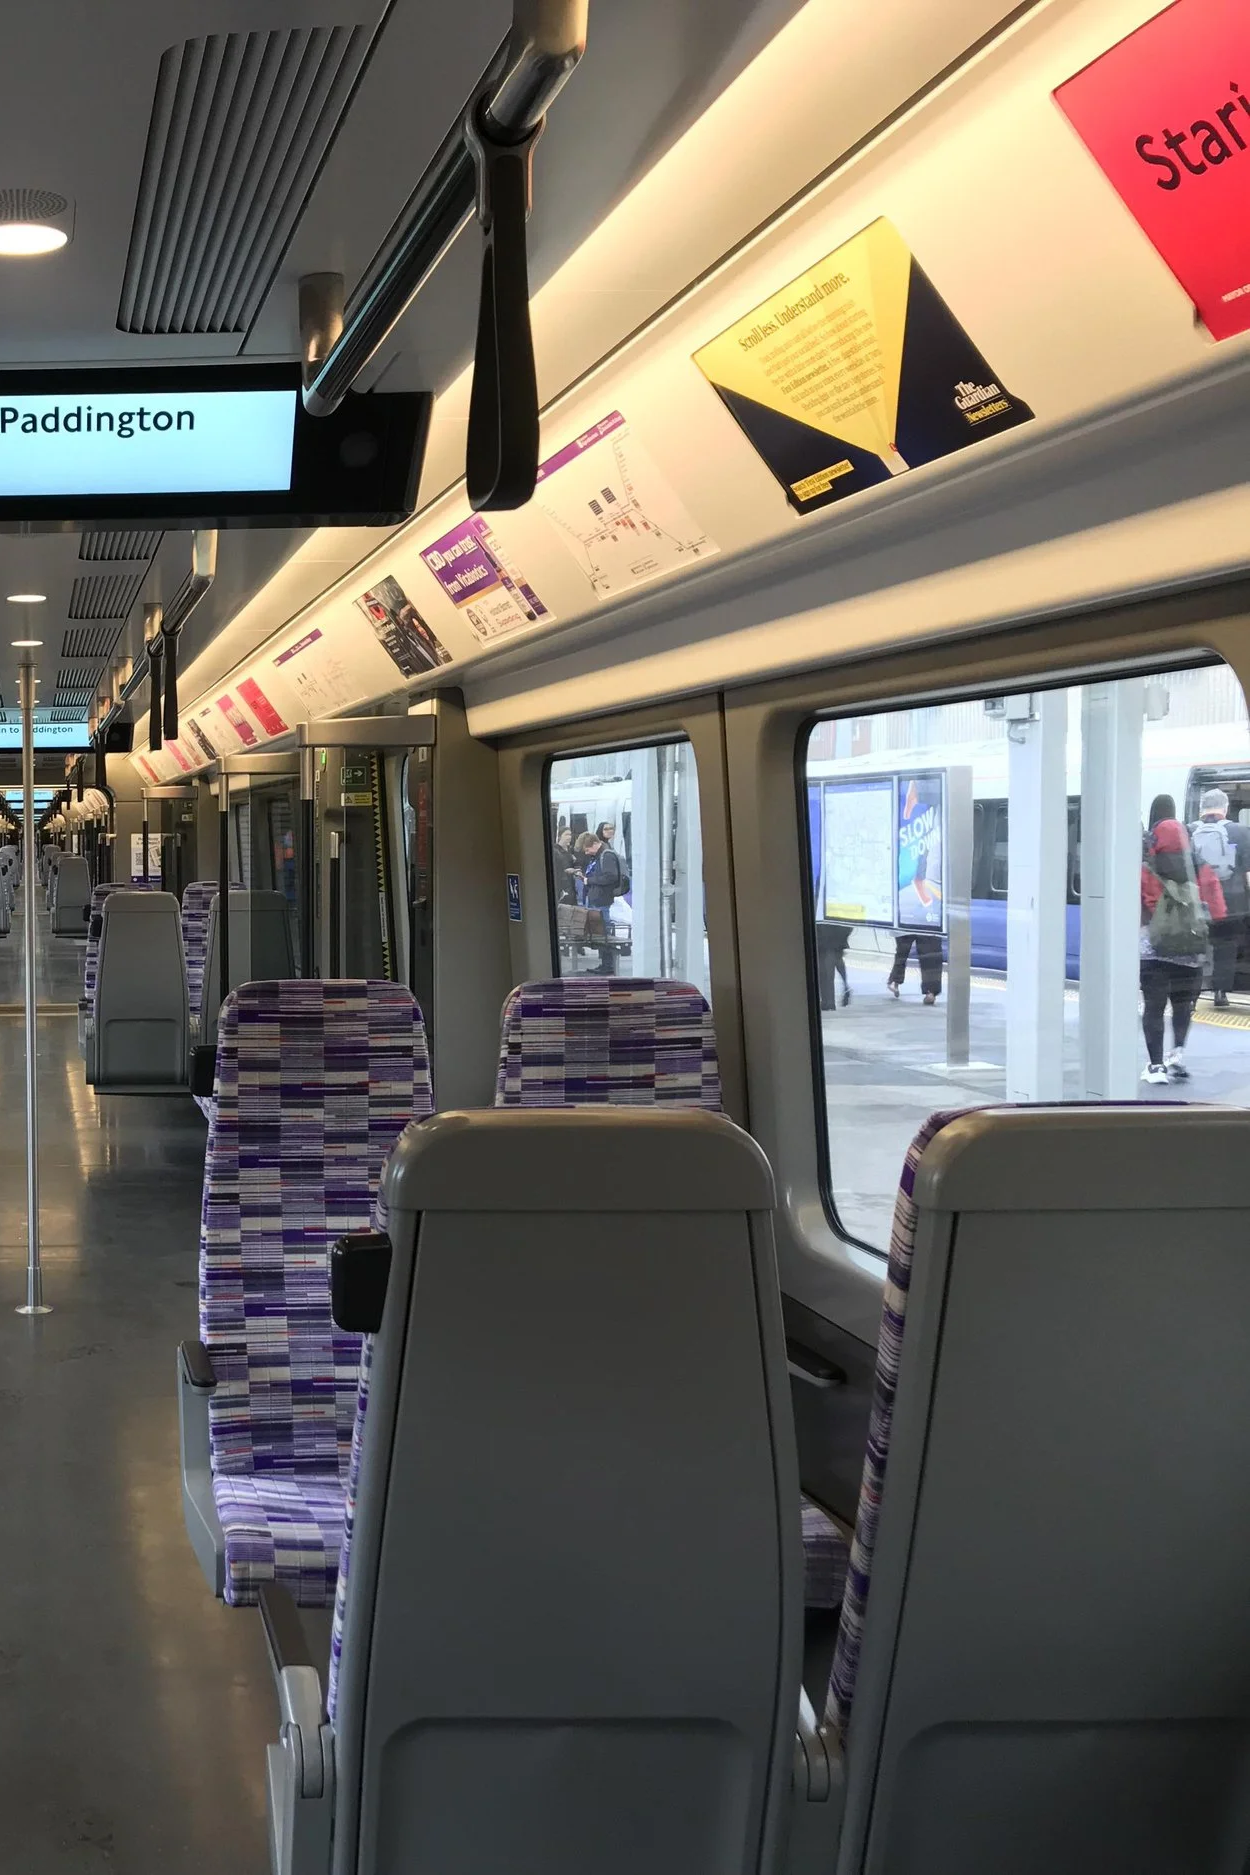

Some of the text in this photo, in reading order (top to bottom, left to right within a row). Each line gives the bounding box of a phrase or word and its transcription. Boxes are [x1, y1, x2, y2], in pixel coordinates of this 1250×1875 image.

[739, 274, 849, 351] Scroll less. Understand more.
[955, 381, 978, 396] The
[955, 384, 1000, 409] Guardian
[0, 406, 194, 438] Paddington
[965, 400, 1008, 422] Newsletters
[427, 535, 476, 570] CBD you can trust
[444, 565, 488, 594] from Vitabiotics
[33, 726, 73, 734] ddington
[899, 806, 934, 847] SLOW
[910, 826, 940, 860] DOWN
